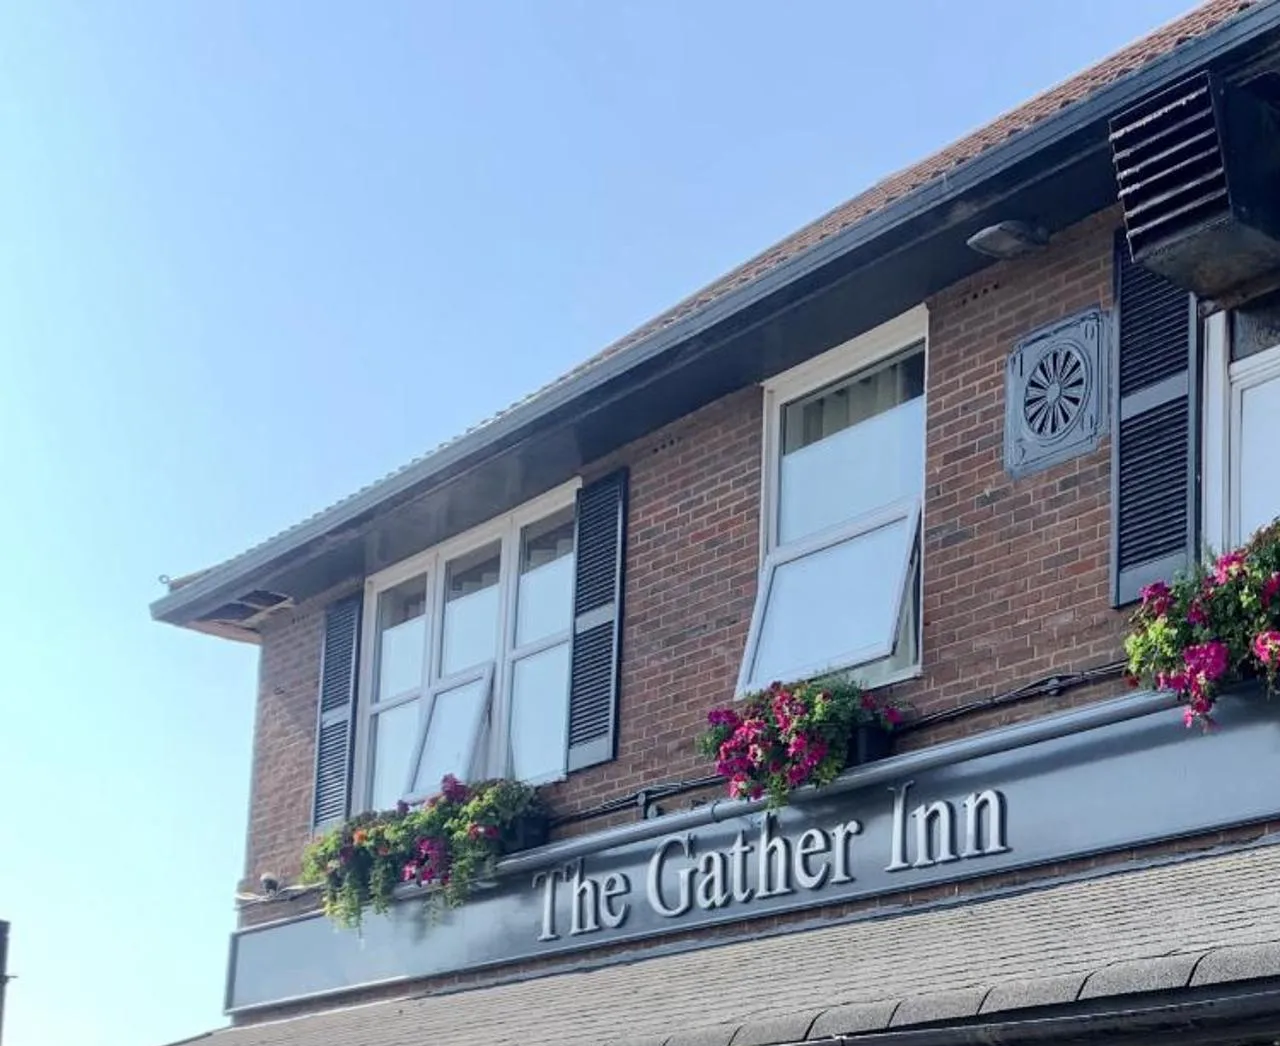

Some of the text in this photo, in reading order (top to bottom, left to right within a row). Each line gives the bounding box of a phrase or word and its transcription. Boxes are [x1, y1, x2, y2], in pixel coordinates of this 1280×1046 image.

[532, 780, 1013, 941] The Gather Inn
